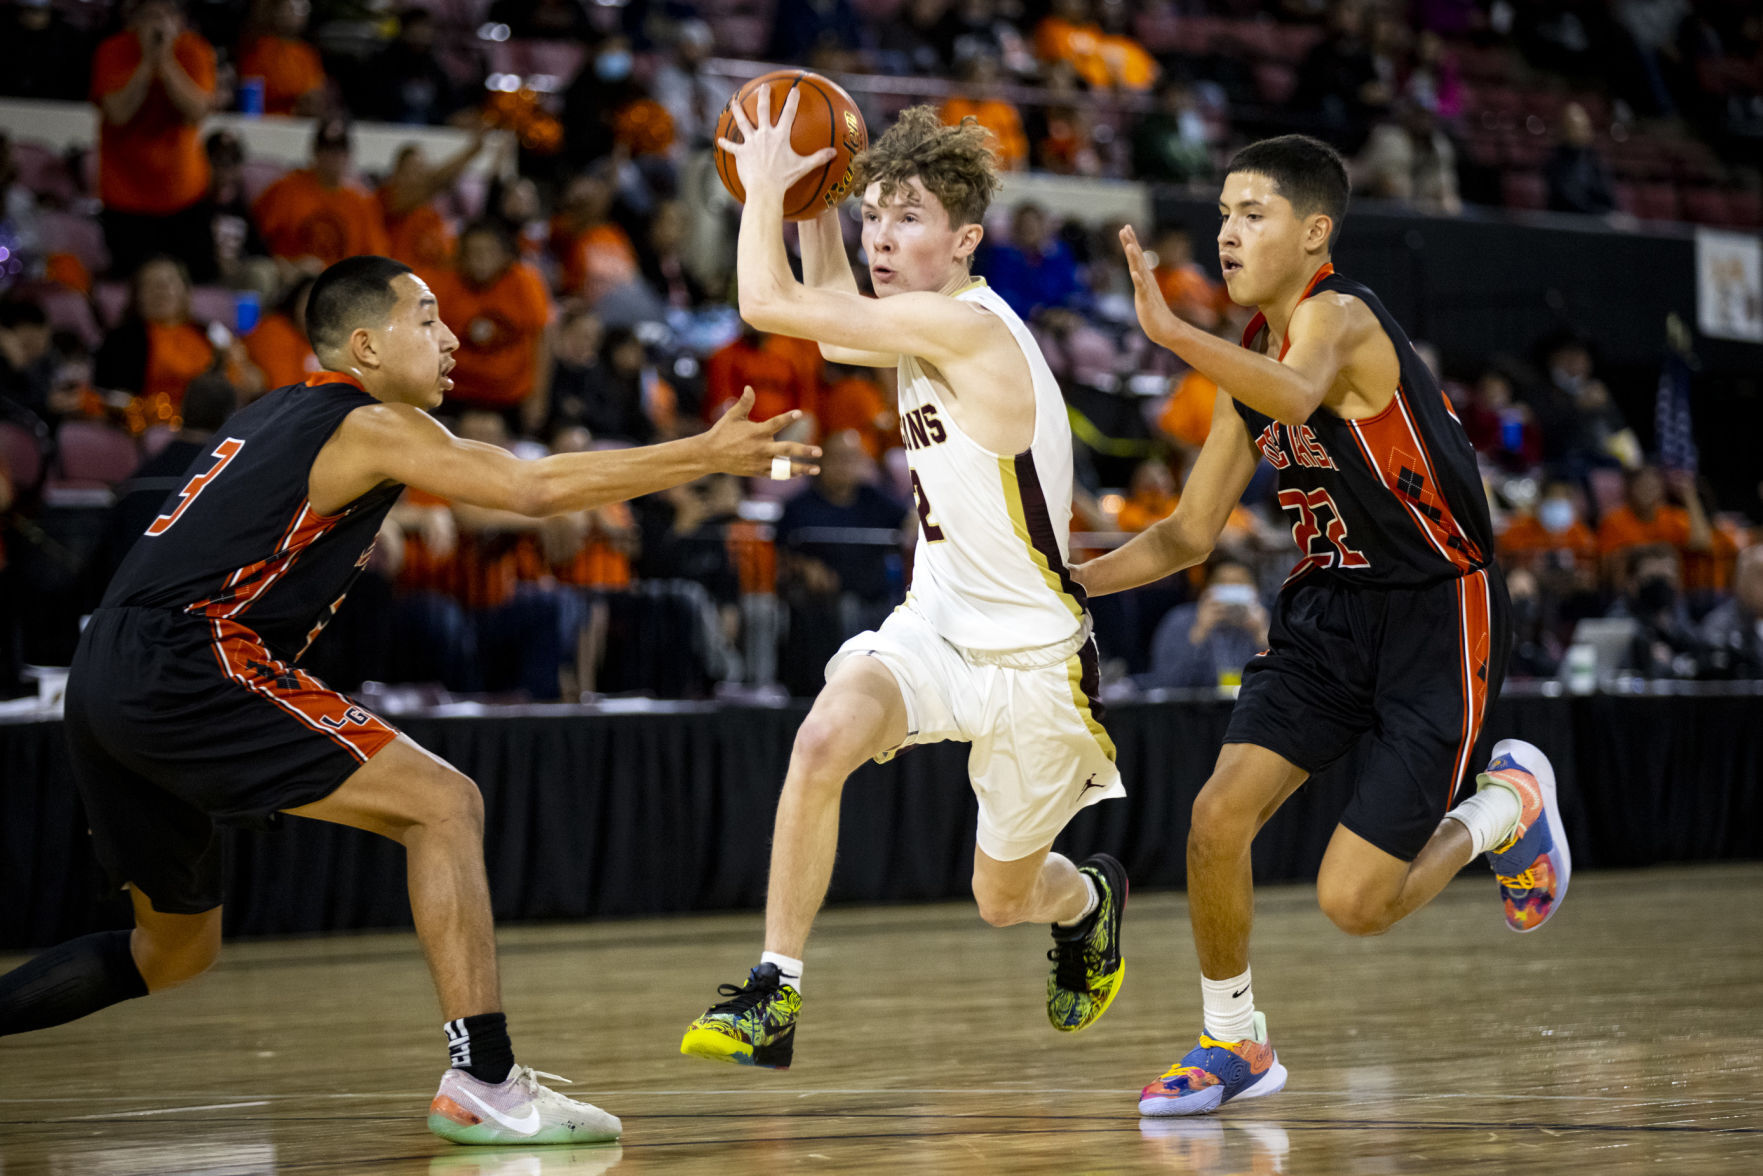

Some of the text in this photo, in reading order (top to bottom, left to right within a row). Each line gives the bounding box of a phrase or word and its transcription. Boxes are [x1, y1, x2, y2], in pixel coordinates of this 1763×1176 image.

[143, 436, 246, 537] 3
[1277, 486, 1371, 570] 22
[319, 705, 371, 730] LG
